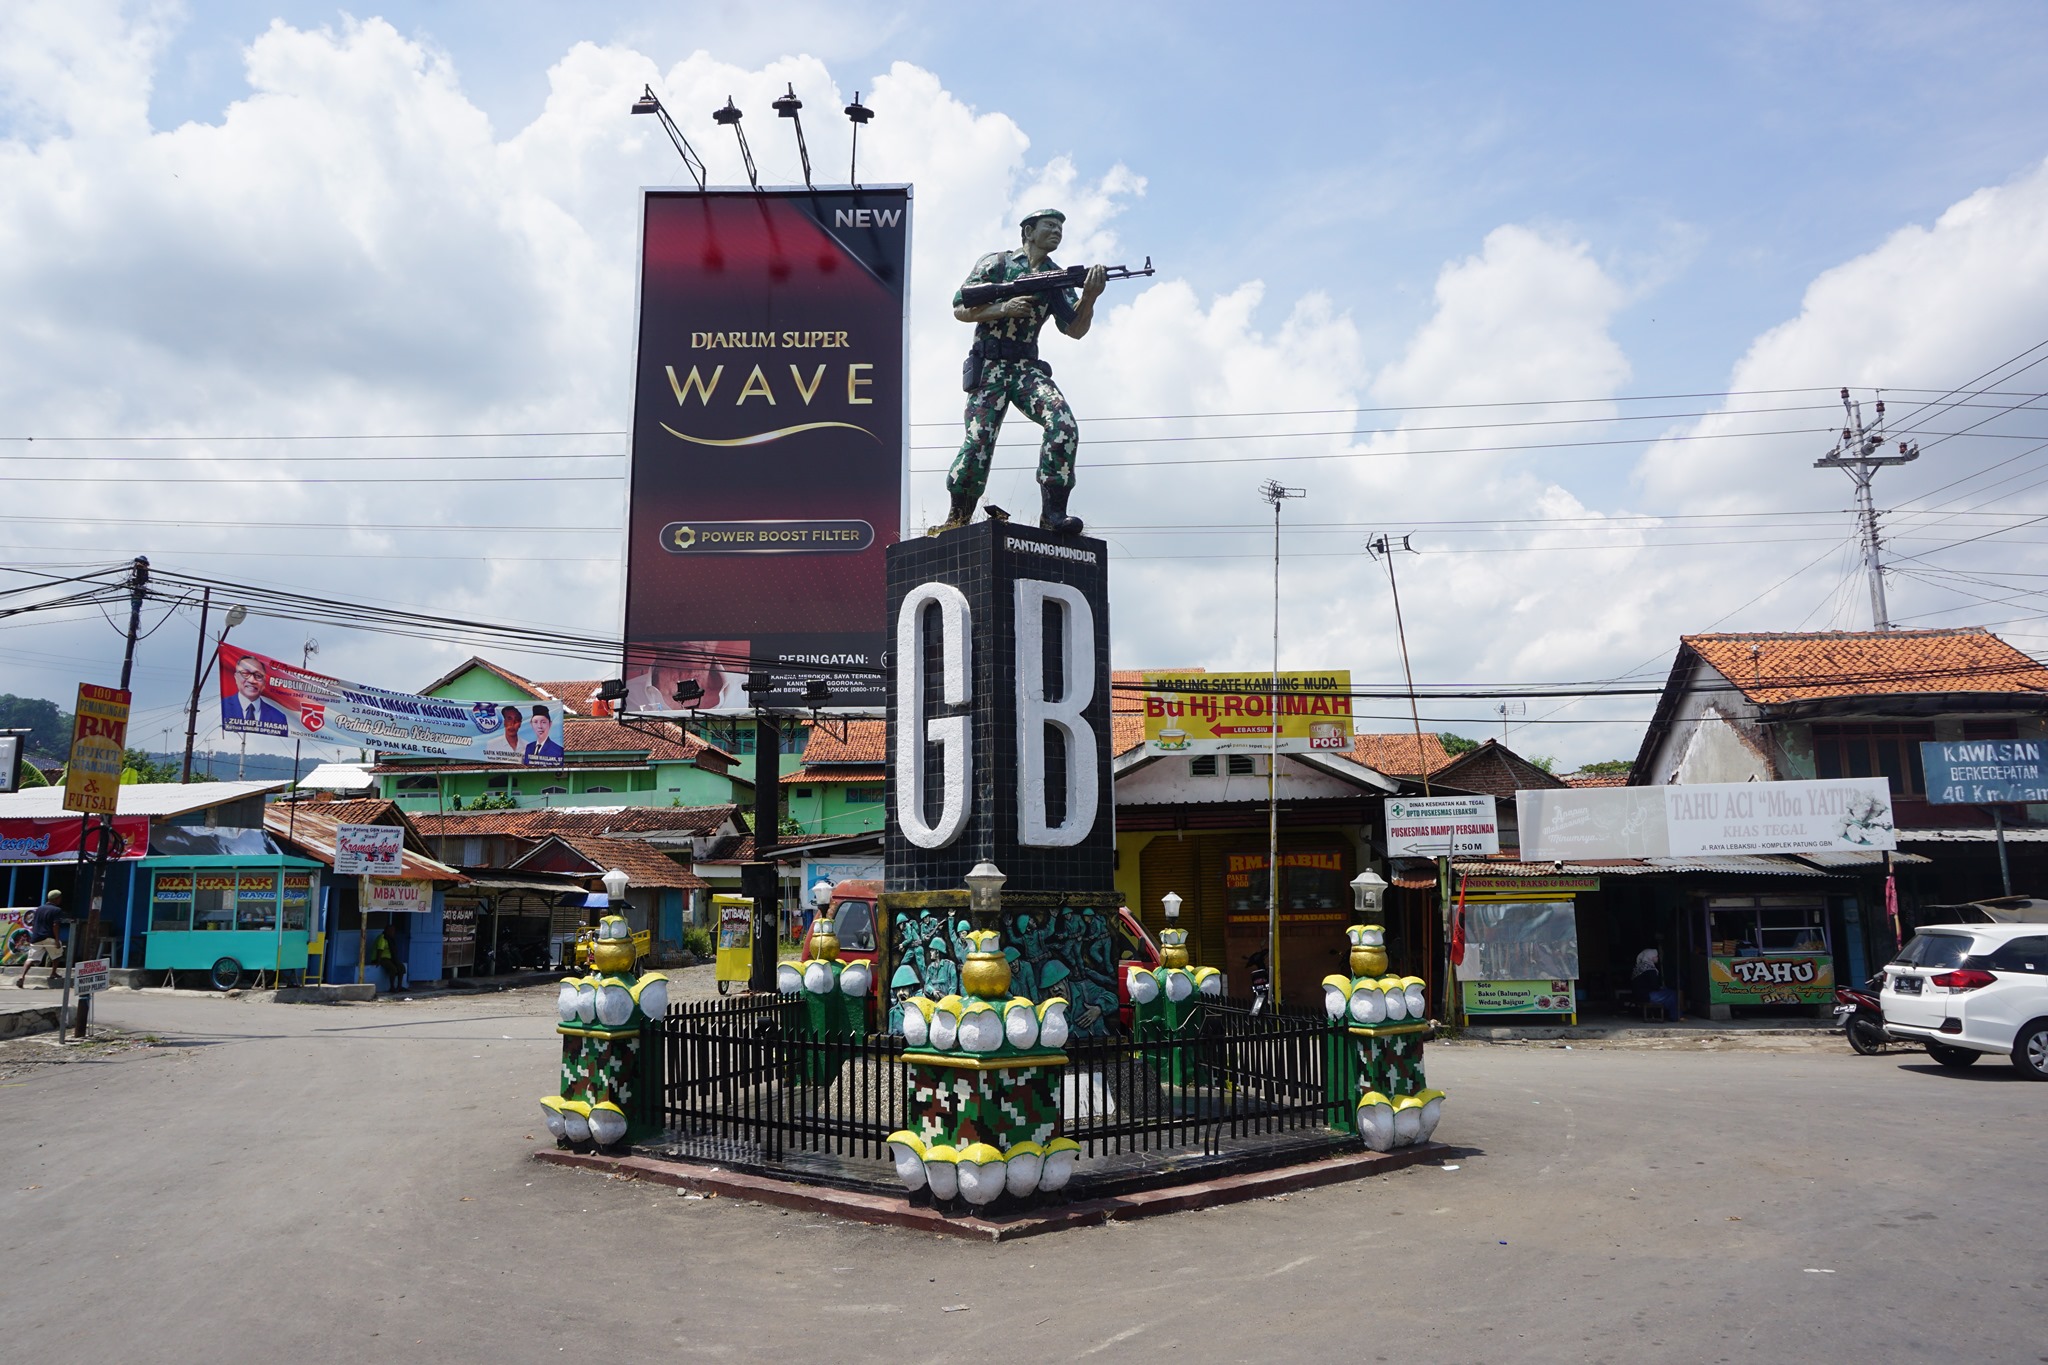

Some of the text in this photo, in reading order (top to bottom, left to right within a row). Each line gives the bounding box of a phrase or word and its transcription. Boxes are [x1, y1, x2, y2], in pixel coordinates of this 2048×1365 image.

[835, 209, 901, 228] NEW
[691, 331, 850, 350] DJARUM SUPER
[664, 363, 874, 406] WAVE
[702, 529, 860, 542] POWER BOOST FILTER
[1007, 537, 1096, 563] PANTANG MUNDUR
[779, 654, 869, 664] PERINGATAN:
[270, 677, 303, 690] REPUBLIK
[1157, 678, 1209, 691] WARUNG
[1212, 678, 1241, 691] SATE
[1304, 677, 1338, 690] MUDA
[93, 687, 123, 702] 100 m
[342, 690, 380, 711] PARTAI
[380, 697, 420, 716] AMANAT
[420, 703, 469, 721] NASIONAL
[362, 708, 394, 719] AGUSTUS
[1014, 579, 1098, 847] B
[1147, 696, 1184, 717] Bu
[479, 718, 496, 726] PAN
[897, 582, 972, 848] G
[75, 714, 127, 750] RM
[229, 717, 288, 731] ZULKIFLI HASAN
[335, 714, 473, 746] Peduli Dalam Kebersamaan
[366, 738, 447, 755] DPD PAN KAB. TEGAL
[1312, 738, 1343, 748] POCI
[76, 745, 120, 760] BUKIT
[1943, 743, 2040, 762] KAWASAN
[1950, 765, 2039, 781] BERKECEPATAN
[1942, 785, 1965, 802] 40
[67, 793, 116, 811] FUTSAL
[1671, 791, 1718, 821] TAHU
[1724, 791, 1754, 819] ACI
[1421, 808, 1452, 817] PUSKESMAS
[1391, 826, 1430, 838] PUSKESMAS
[1456, 824, 1494, 835] PERSALINAN
[1723, 823, 1807, 838] KHAS TEGAL
[0, 833, 51, 856] esepsi
[1229, 855, 1269, 872] RM.
[284, 876, 309, 888] MANIS
[1495, 880, 1520, 889] SOTO,
[1559, 879, 1595, 887] BAJIGUR
[156, 891, 192, 900] TELOR
[239, 891, 277, 900] MANIS
[373, 887, 419, 900] MBA YULI
[1233, 913, 1341, 922] MASAAN PADANG
[1735, 961, 1817, 983] TAHU
